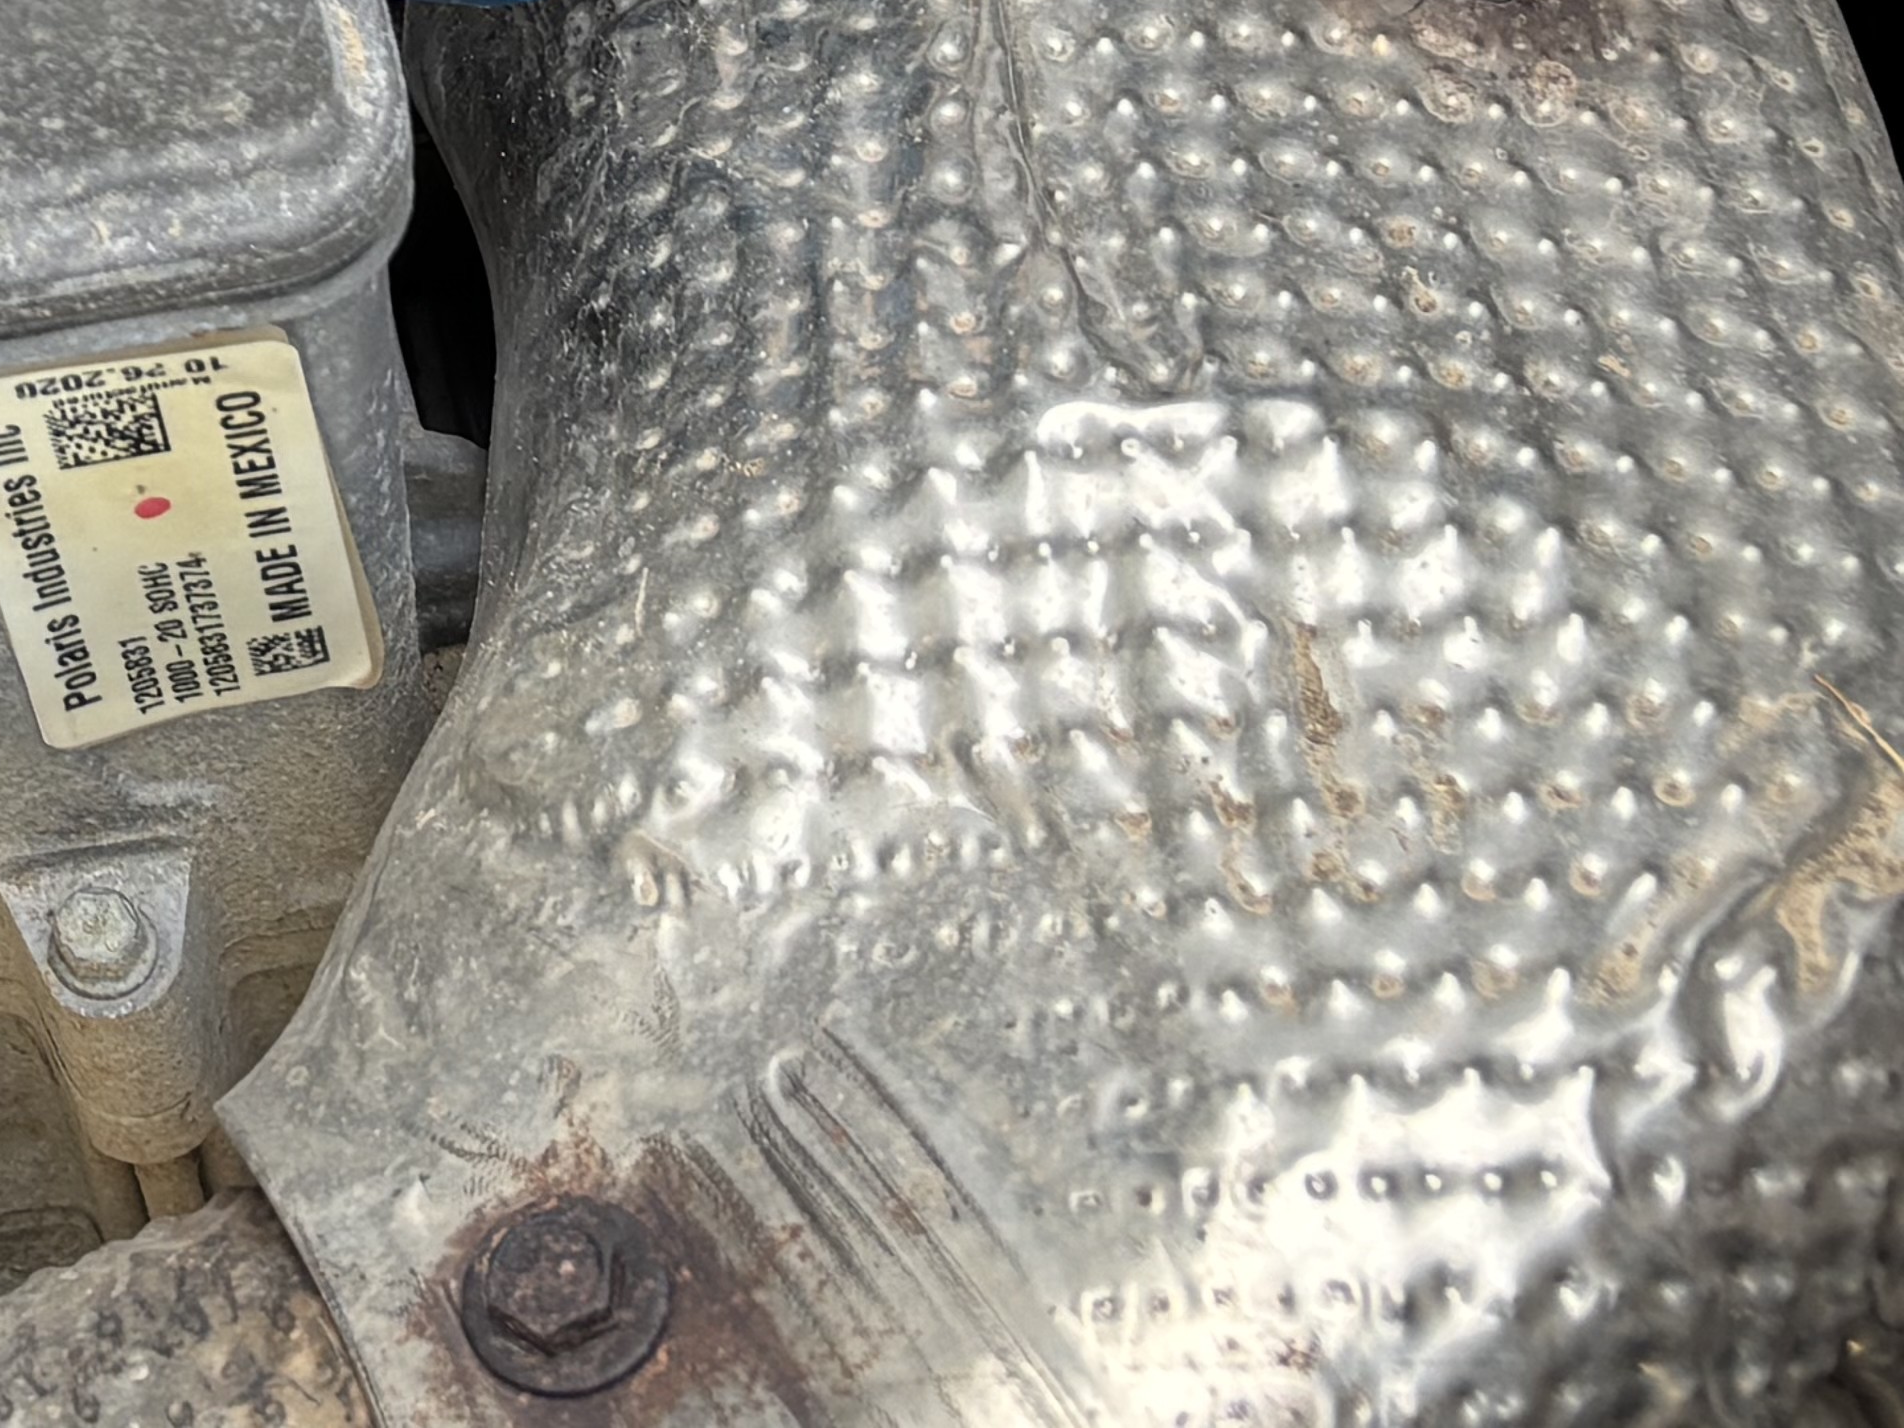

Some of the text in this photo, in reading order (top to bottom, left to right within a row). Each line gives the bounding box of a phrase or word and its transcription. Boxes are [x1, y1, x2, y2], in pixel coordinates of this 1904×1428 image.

[3, 474, 72, 612] Industries
[215, 390, 313, 623] MADE IN MEXICO
[137, 561, 179, 617] SOHC
[46, 613, 103, 712] Polaris
[118, 634, 167, 715] 1205831
